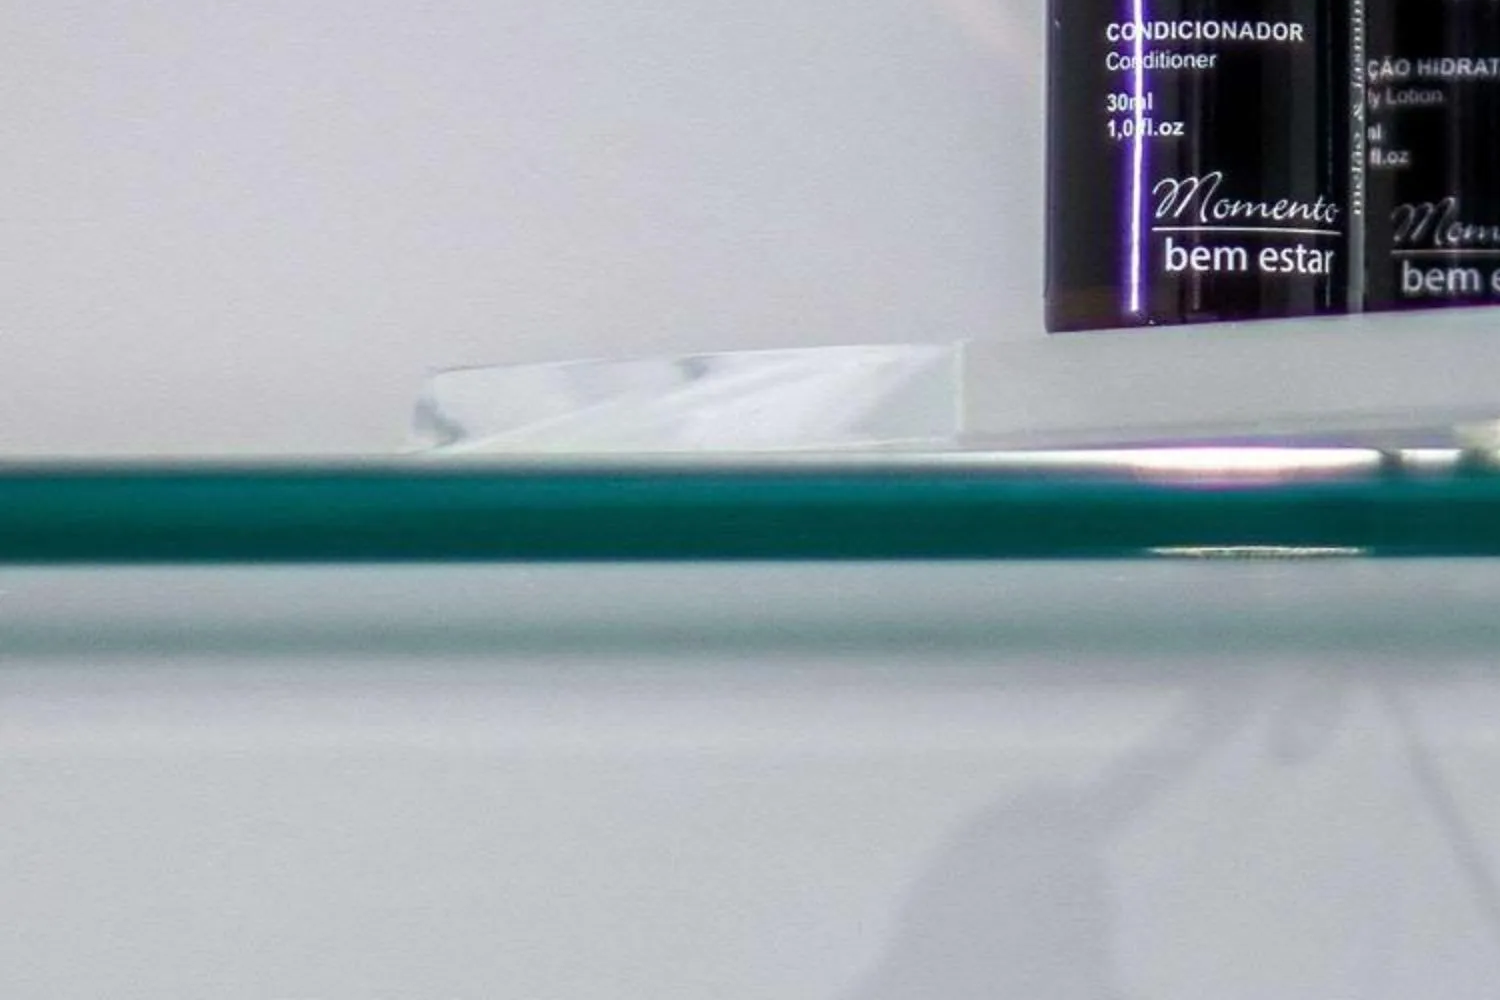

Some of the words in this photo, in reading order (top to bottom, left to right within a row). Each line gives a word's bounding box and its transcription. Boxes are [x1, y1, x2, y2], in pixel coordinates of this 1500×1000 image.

[1106, 20, 1304, 42] CONDICIONADOR
[1105, 51, 1217, 71] Conditioner
[1367, 55, 1411, 83] ÇÃO
[1106, 91, 1154, 112] 30ml
[1106, 118, 1134, 140] 1,0
[1152, 171, 1340, 224] Momento
[1165, 237, 1248, 273] bem
[1259, 243, 1335, 274] estar
[1403, 260, 1481, 292] bem
